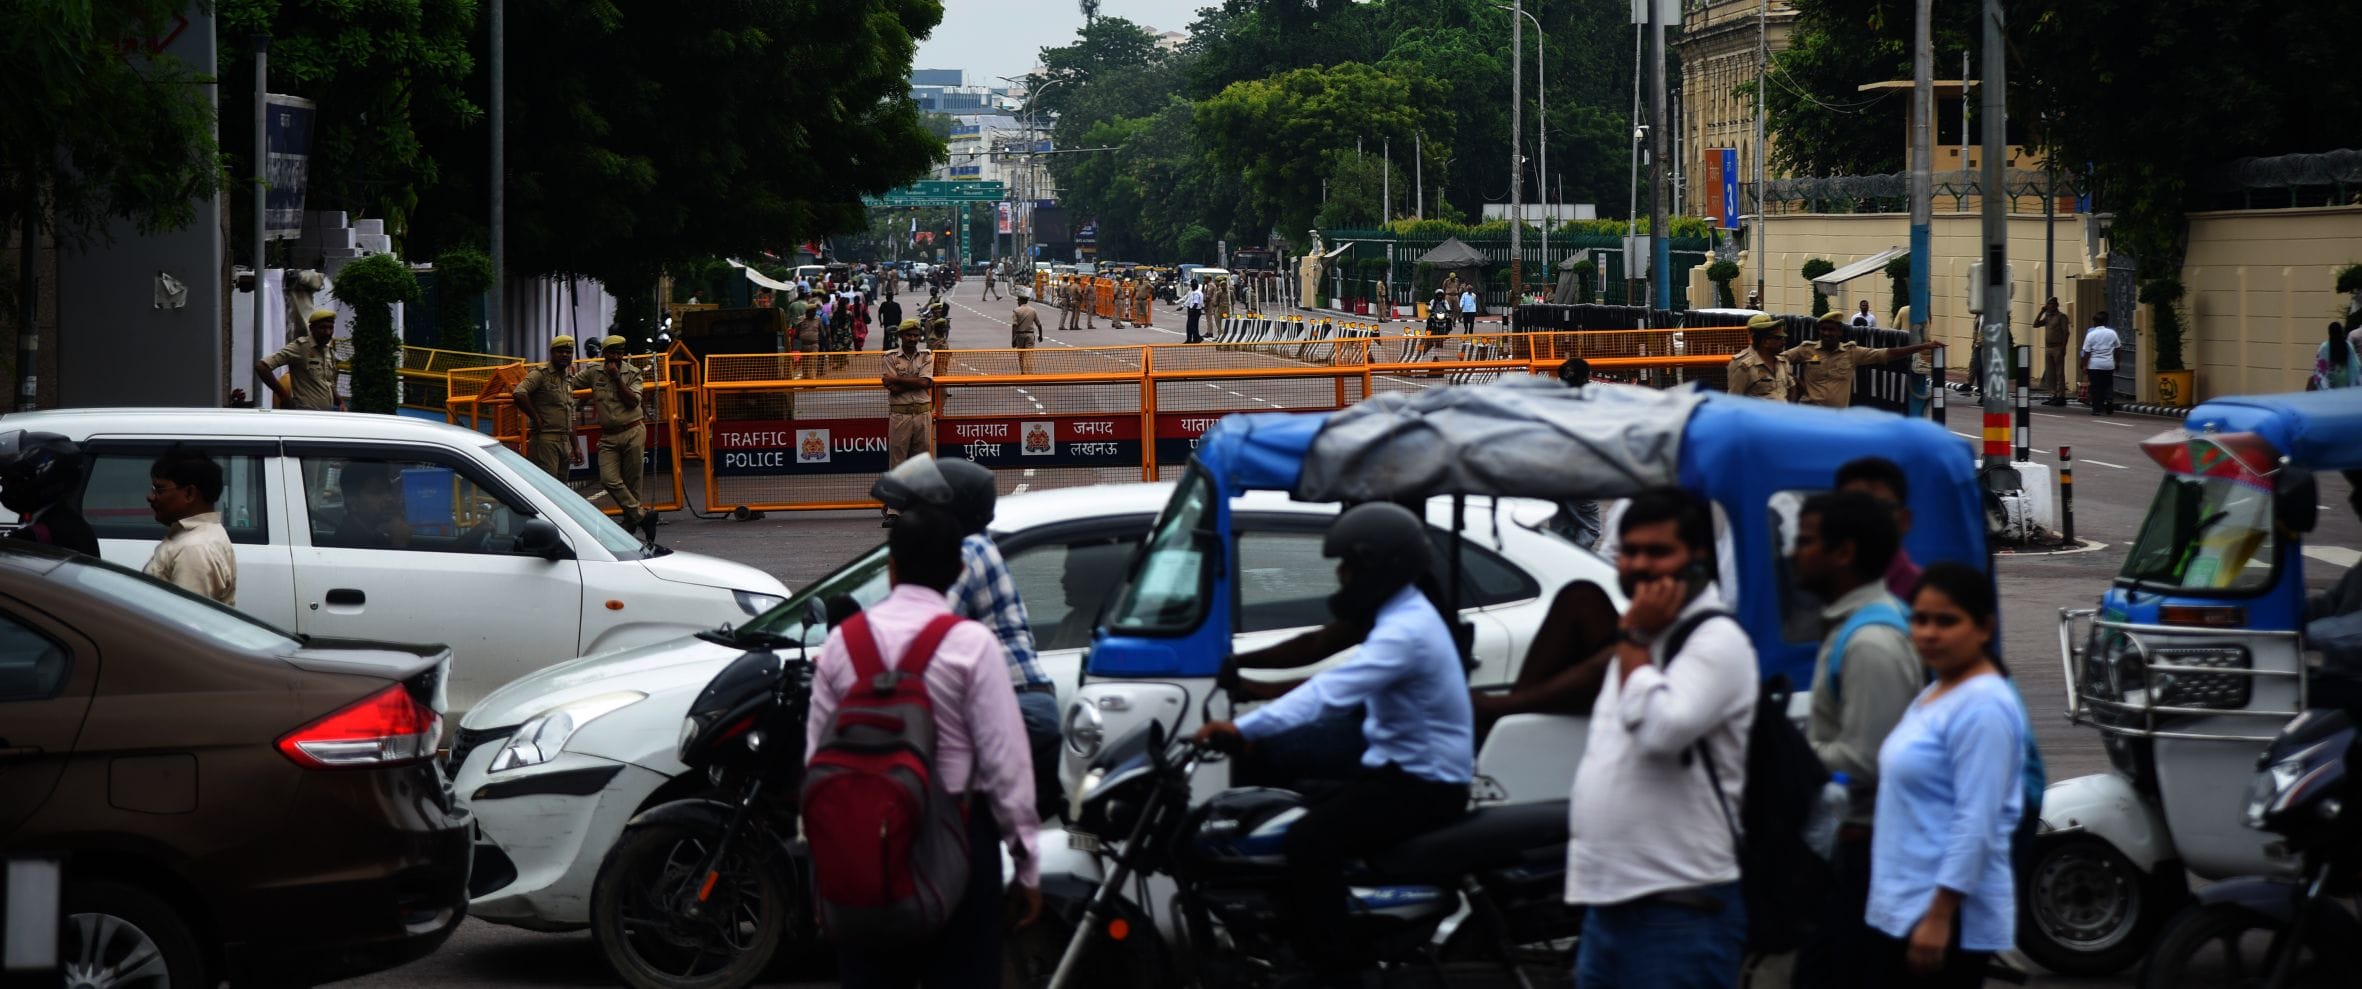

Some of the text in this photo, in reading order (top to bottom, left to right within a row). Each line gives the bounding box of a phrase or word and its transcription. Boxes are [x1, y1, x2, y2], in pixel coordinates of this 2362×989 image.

[1727, 183, 1734, 217] 3
[956, 423, 1009, 437] यातायात
[1073, 421, 1114, 435] जनपद
[721, 431, 787, 447] TRAFFIC
[834, 437, 888, 453] LUCKN
[964, 439, 1002, 462] पुलिस
[1070, 442, 1118, 456] लखनऊ
[726, 452, 784, 468] POLICE
